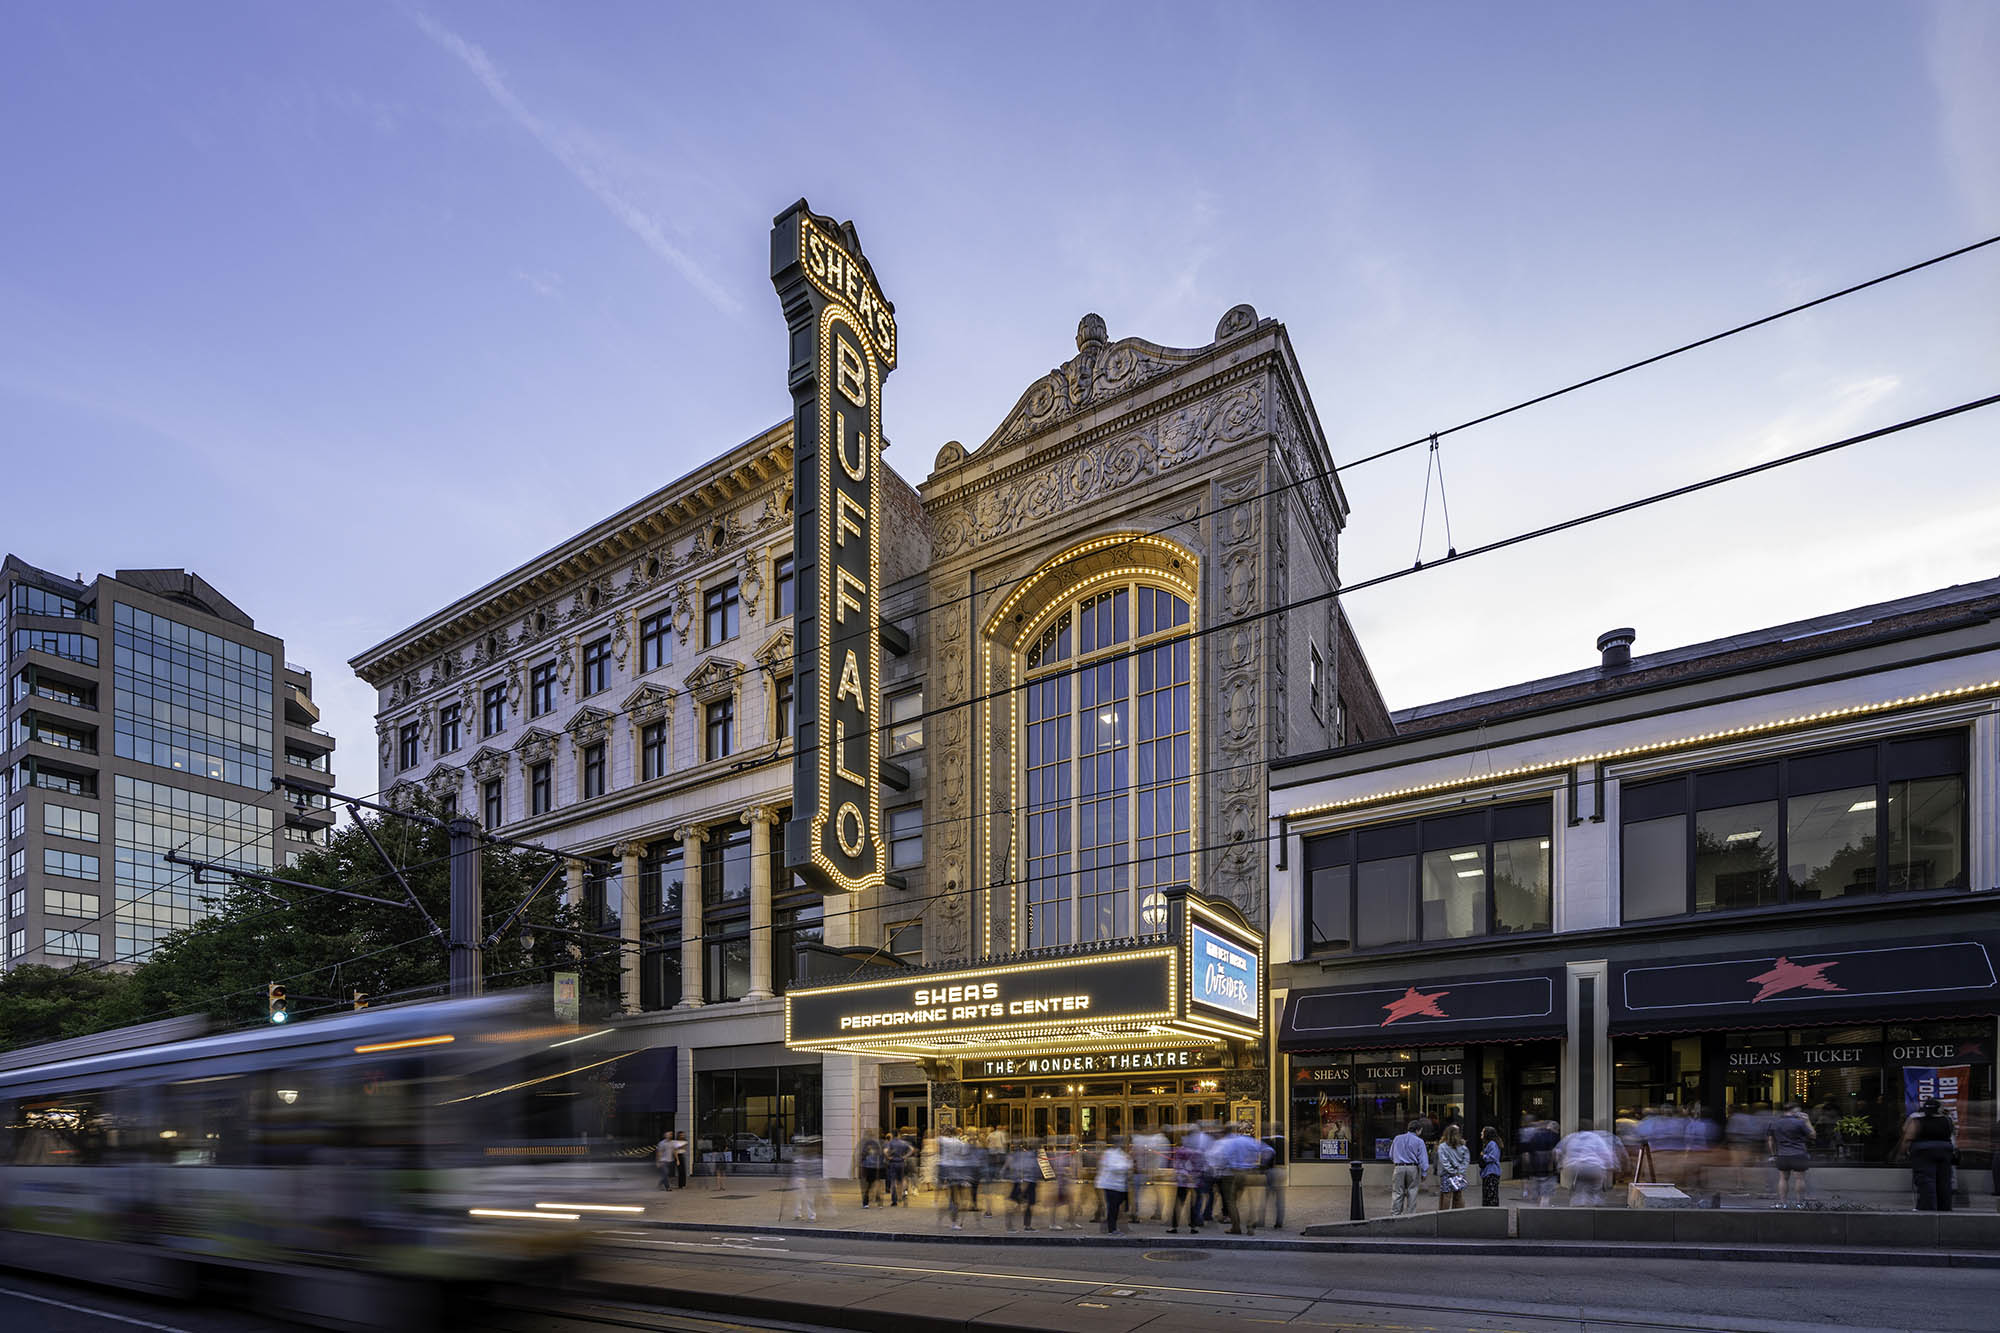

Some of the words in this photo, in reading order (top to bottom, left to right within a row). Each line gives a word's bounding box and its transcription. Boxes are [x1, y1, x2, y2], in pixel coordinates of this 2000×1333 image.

[809, 233, 890, 350] SHEA'S
[836, 332, 867, 858] BUFFALO
[840, 1007, 947, 1030] PERFORMING
[952, 1003, 1003, 1020] ARTS
[1009, 995, 1090, 1015] CENTER
[986, 1061, 1014, 1075] THE
[1028, 1056, 1094, 1073] WONDER
[1108, 1051, 1189, 1069] THEATRE
[1729, 1051, 1782, 1066] SHEA'S
[1803, 1048, 1863, 1063] TICKET
[1892, 1044, 1955, 1060] OFFICE
[1313, 1068, 1350, 1081] SHEA'S
[1365, 1066, 1406, 1079] TICKET
[1421, 1063, 1463, 1076] OFFICE
